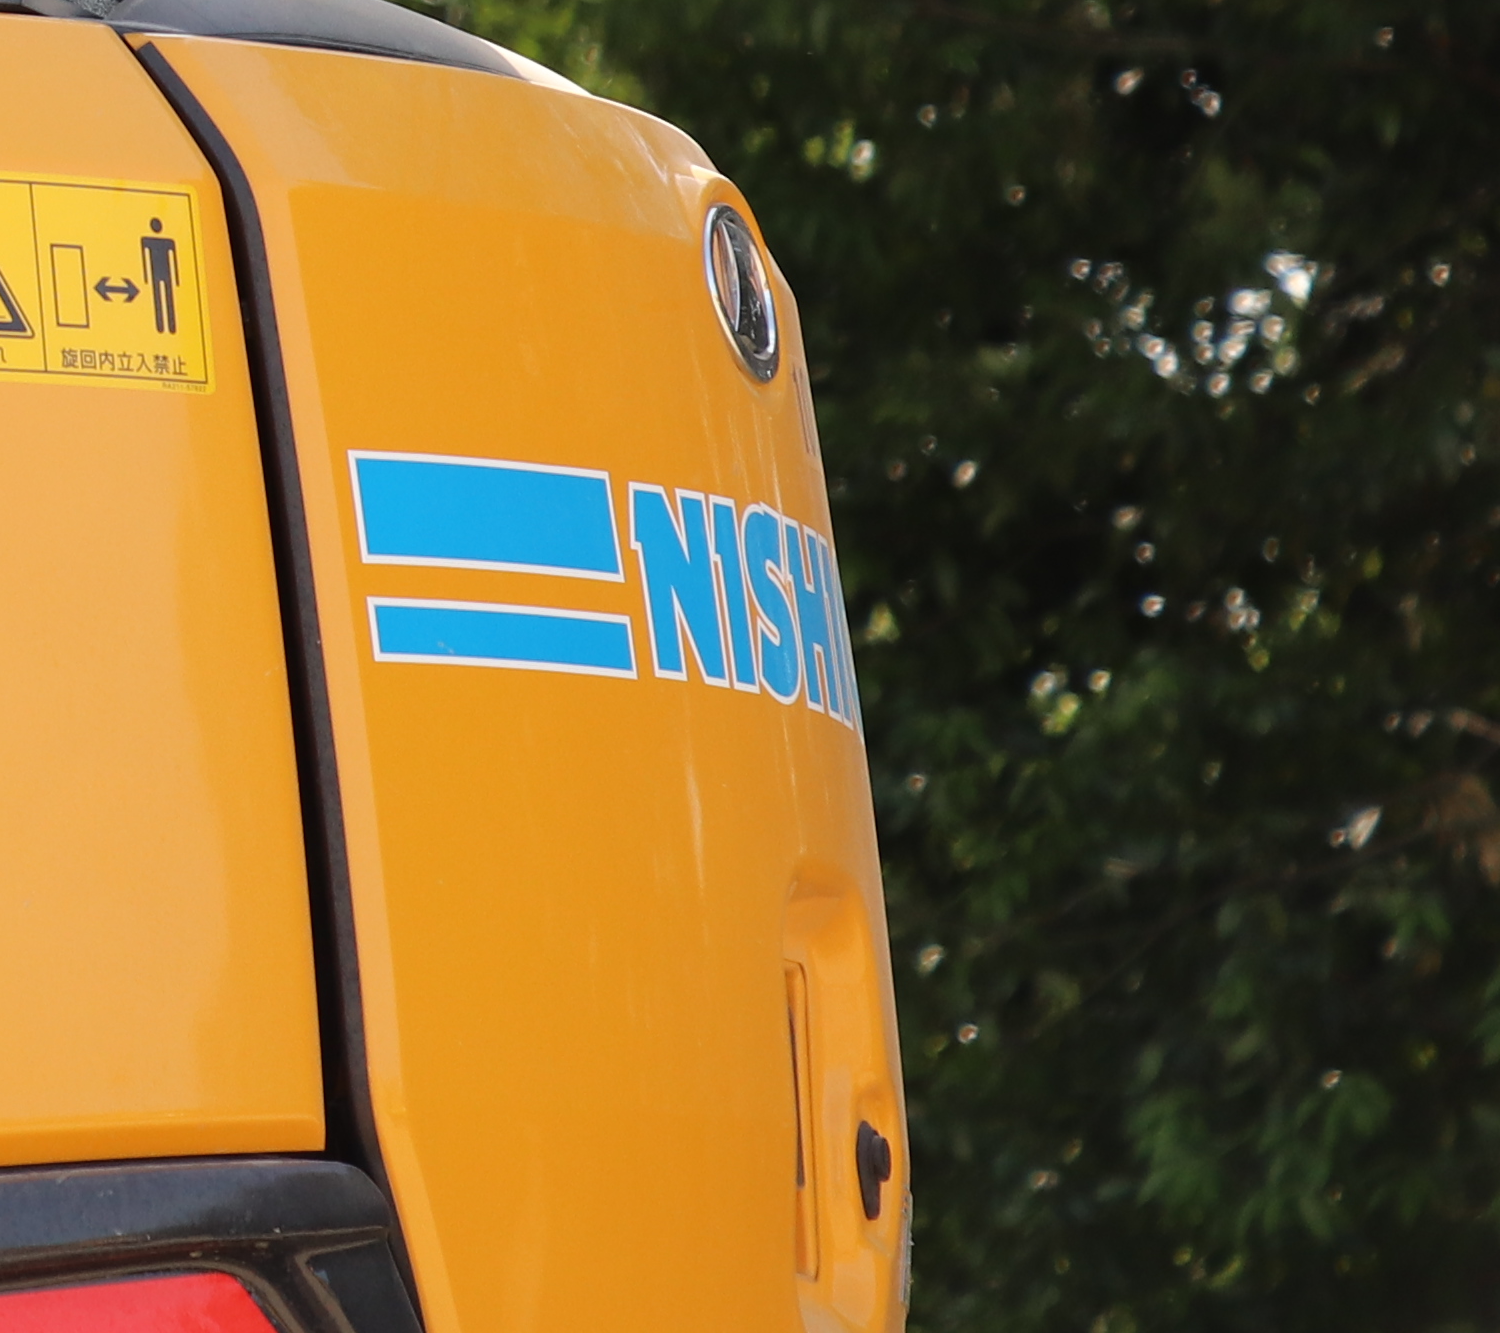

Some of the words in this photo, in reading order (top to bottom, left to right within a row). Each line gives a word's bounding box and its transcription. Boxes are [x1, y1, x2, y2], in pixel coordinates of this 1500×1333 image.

[61, 347, 189, 377] 旋回内立入禁止
